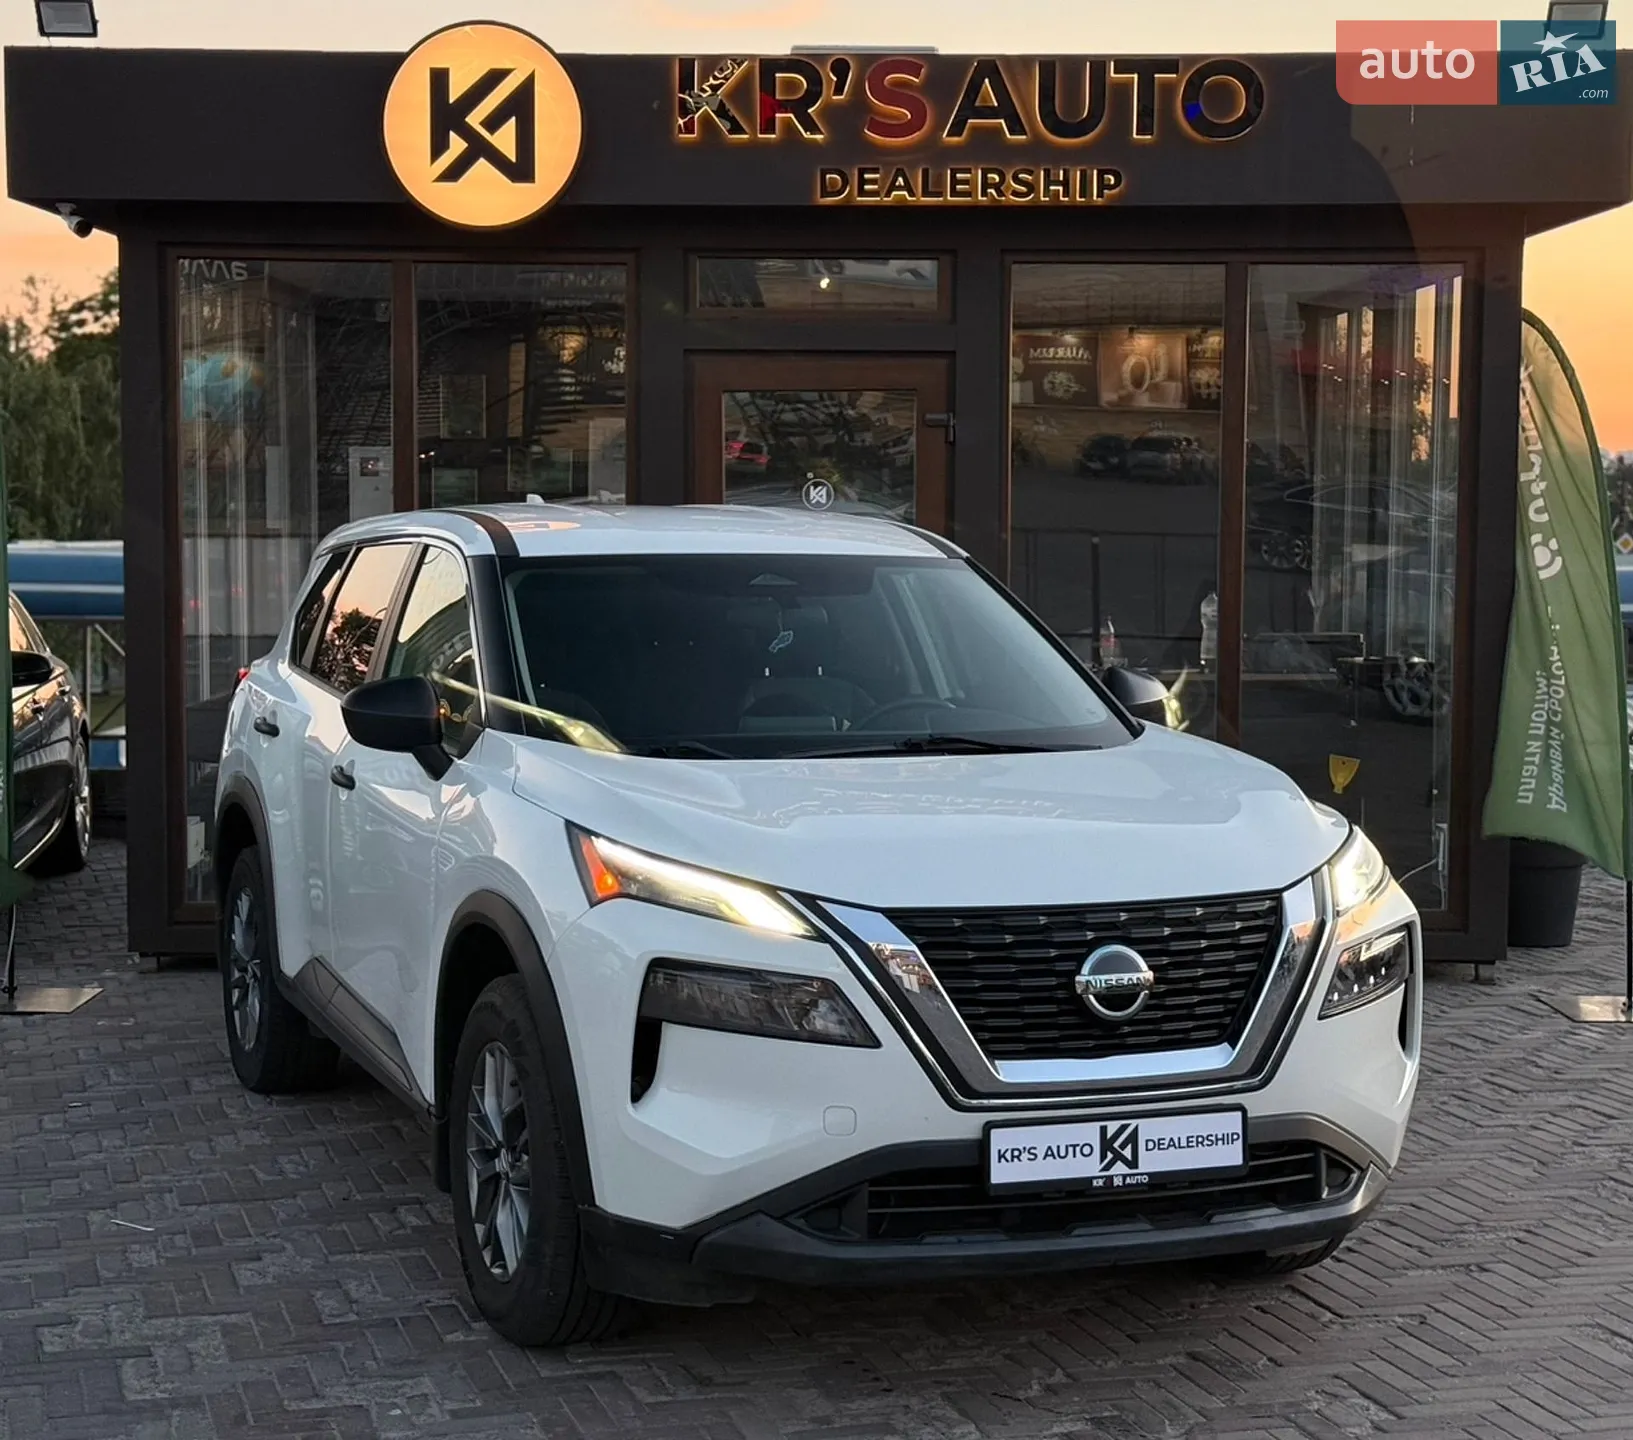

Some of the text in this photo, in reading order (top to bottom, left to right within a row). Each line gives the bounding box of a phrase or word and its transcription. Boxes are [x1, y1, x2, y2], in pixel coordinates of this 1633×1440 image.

[676, 56, 1265, 141] KR'S AUTO
[817, 166, 1124, 201] DEALERSHIP
[1085, 976, 1146, 989] NISSAN
[997, 1146, 1038, 1163] KR'S
[1042, 1143, 1094, 1161] AUTO
[1144, 1132, 1241, 1152] DEALERSHIP
[1125, 1174, 1149, 1185] AUTO
